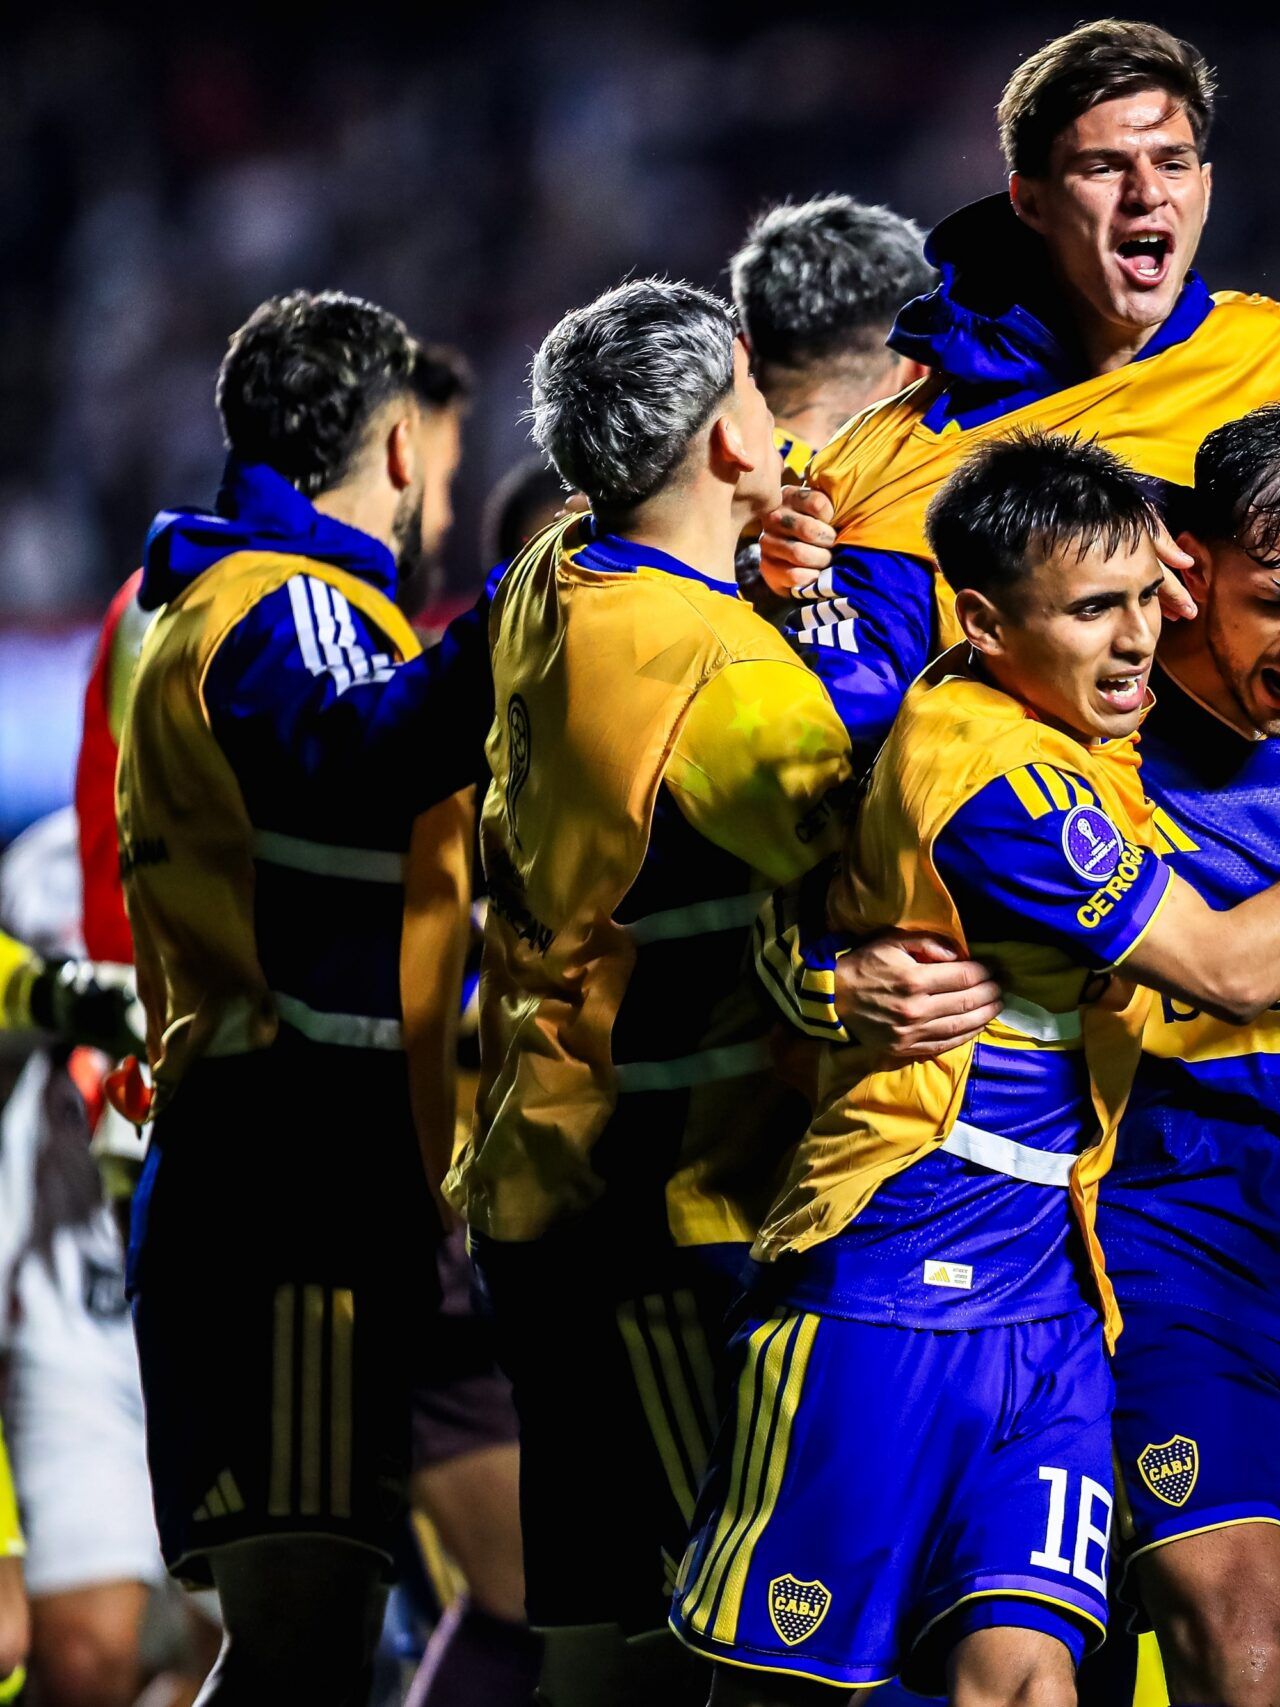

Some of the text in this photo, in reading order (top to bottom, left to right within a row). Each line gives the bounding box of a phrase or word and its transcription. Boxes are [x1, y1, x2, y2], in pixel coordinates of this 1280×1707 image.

[1076, 841, 1145, 929] CEROGA
[1149, 1456, 1193, 1482] CABJ
[774, 1596, 821, 1617] CABJ
